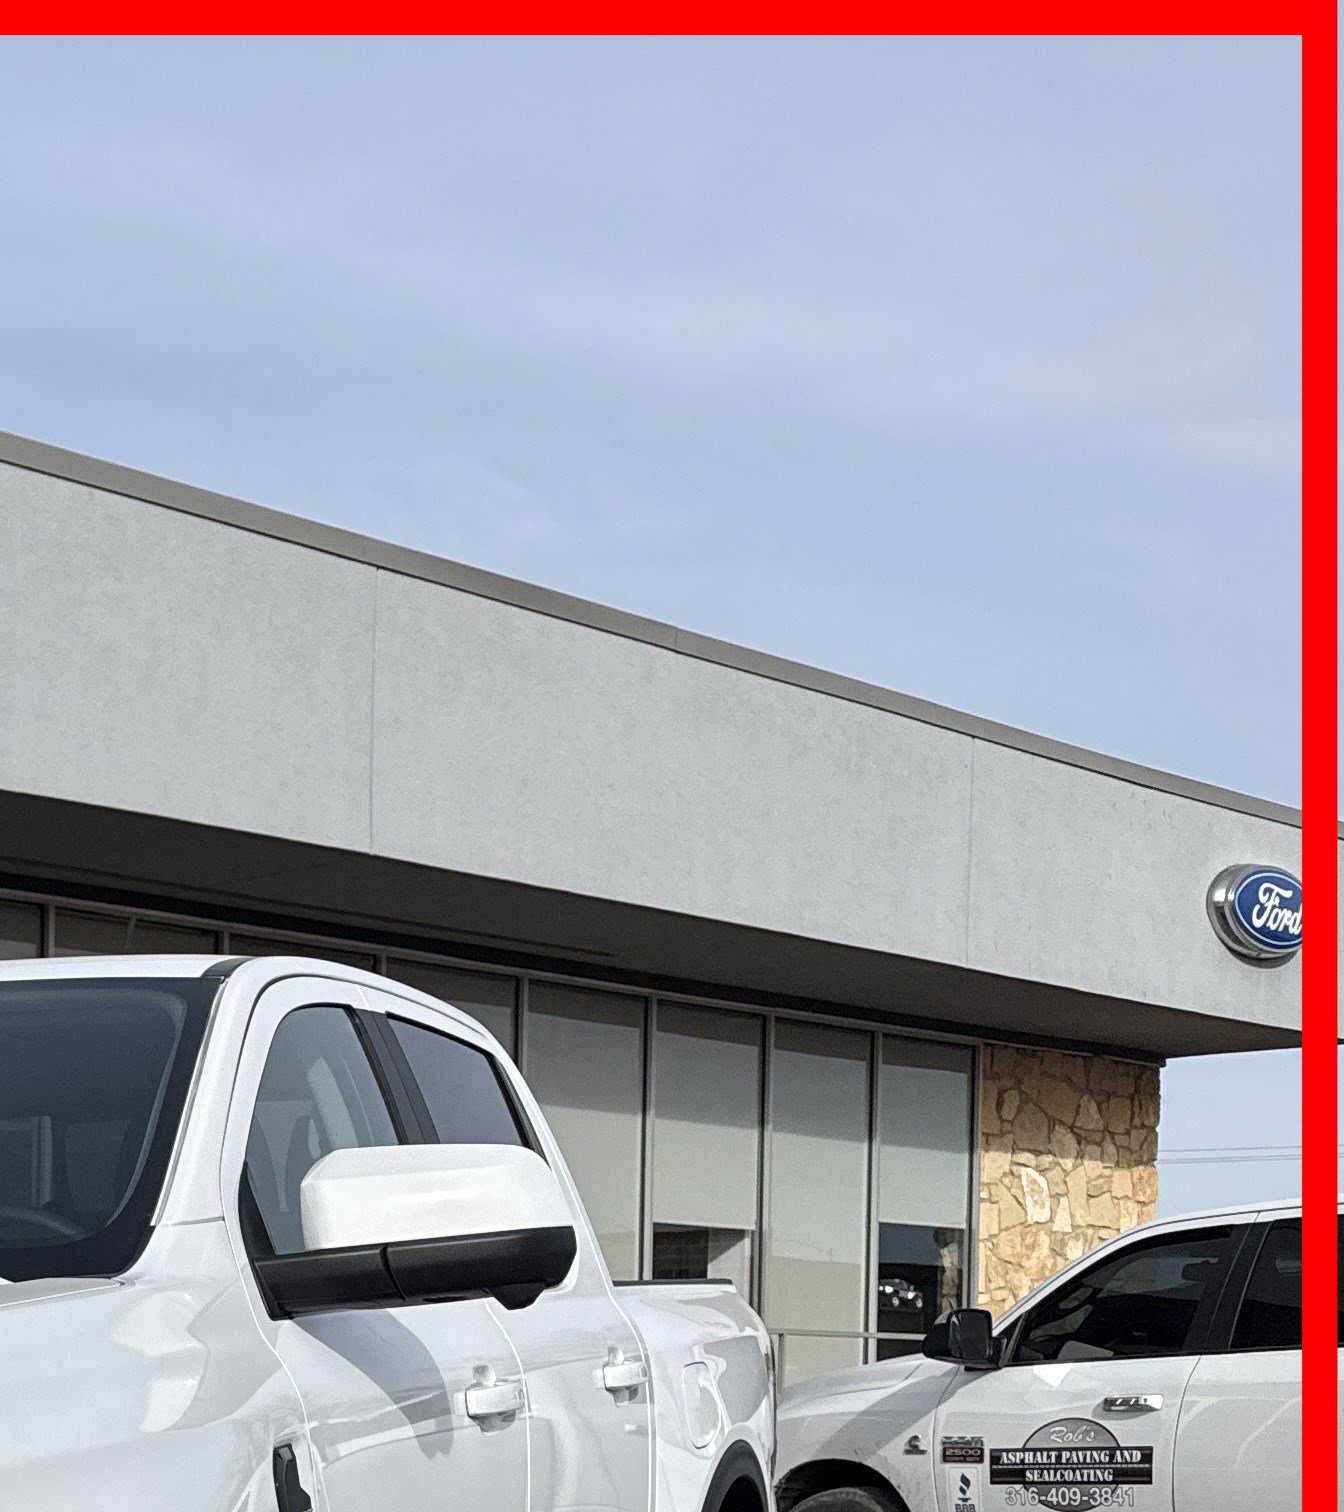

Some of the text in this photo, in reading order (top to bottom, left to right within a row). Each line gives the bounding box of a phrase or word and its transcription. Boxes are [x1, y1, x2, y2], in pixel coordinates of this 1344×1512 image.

[1050, 1424, 1095, 1443] Rob's
[999, 1449, 1142, 1465] ASPHALT PAVING AND
[1025, 1468, 1114, 1483] SEALCOATING
[1005, 1486, 1135, 1508] 316-409-3841
